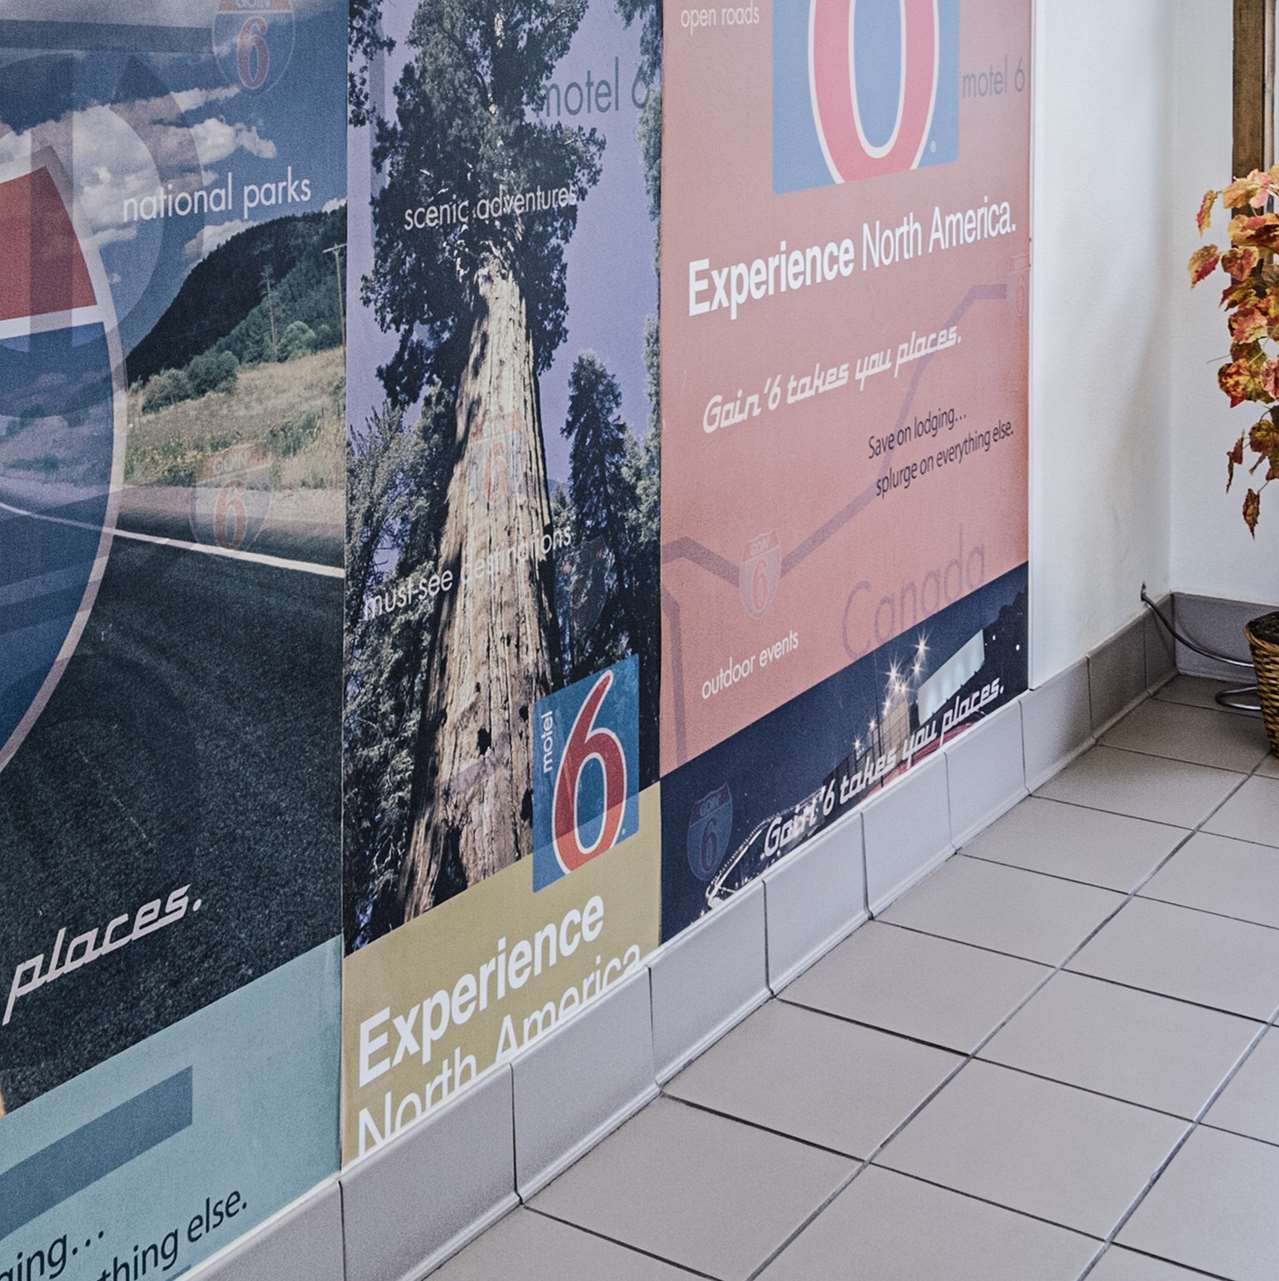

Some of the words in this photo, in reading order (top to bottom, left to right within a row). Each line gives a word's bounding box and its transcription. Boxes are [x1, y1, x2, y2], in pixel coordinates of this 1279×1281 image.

[237, 16, 269, 90] 6
[680, 4, 718, 38] open
[961, 54, 1008, 98] motel
[1014, 55, 1025, 93] 6
[122, 173, 235, 224] national
[243, 165, 312, 216] parks
[404, 197, 469, 231] scenic
[477, 181, 577, 222] adventures
[688, 235, 854, 320] Experience
[862, 212, 923, 272] North
[928, 196, 1017, 252] America.
[787, 362, 850, 406] takes
[854, 352, 892, 391] you
[893, 325, 963, 379] places.
[868, 435, 895, 460] Save
[896, 425, 912, 446] on
[913, 407, 967, 438] lodging...
[876, 462, 918, 500] splurge
[919, 455, 934, 476] on
[936, 429, 991, 465] everything
[992, 419, 1015, 444] else.
[364, 570, 453, 622] must-see
[751, 558, 769, 615] 6
[842, 523, 985, 660] Canada
[701, 654, 756, 700] outdoor
[759, 631, 799, 667] events
[541, 711, 553, 773] motel
[552, 670, 627, 874] 6
[840, 745, 897, 803] takes
[902, 725, 938, 770] you
[939, 676, 1004, 746] places.
[2, 883, 203, 1025] places.
[360, 895, 604, 1088] Experience
[359, 1047, 478, 1158] North
[186, 1190, 248, 1243] else.
